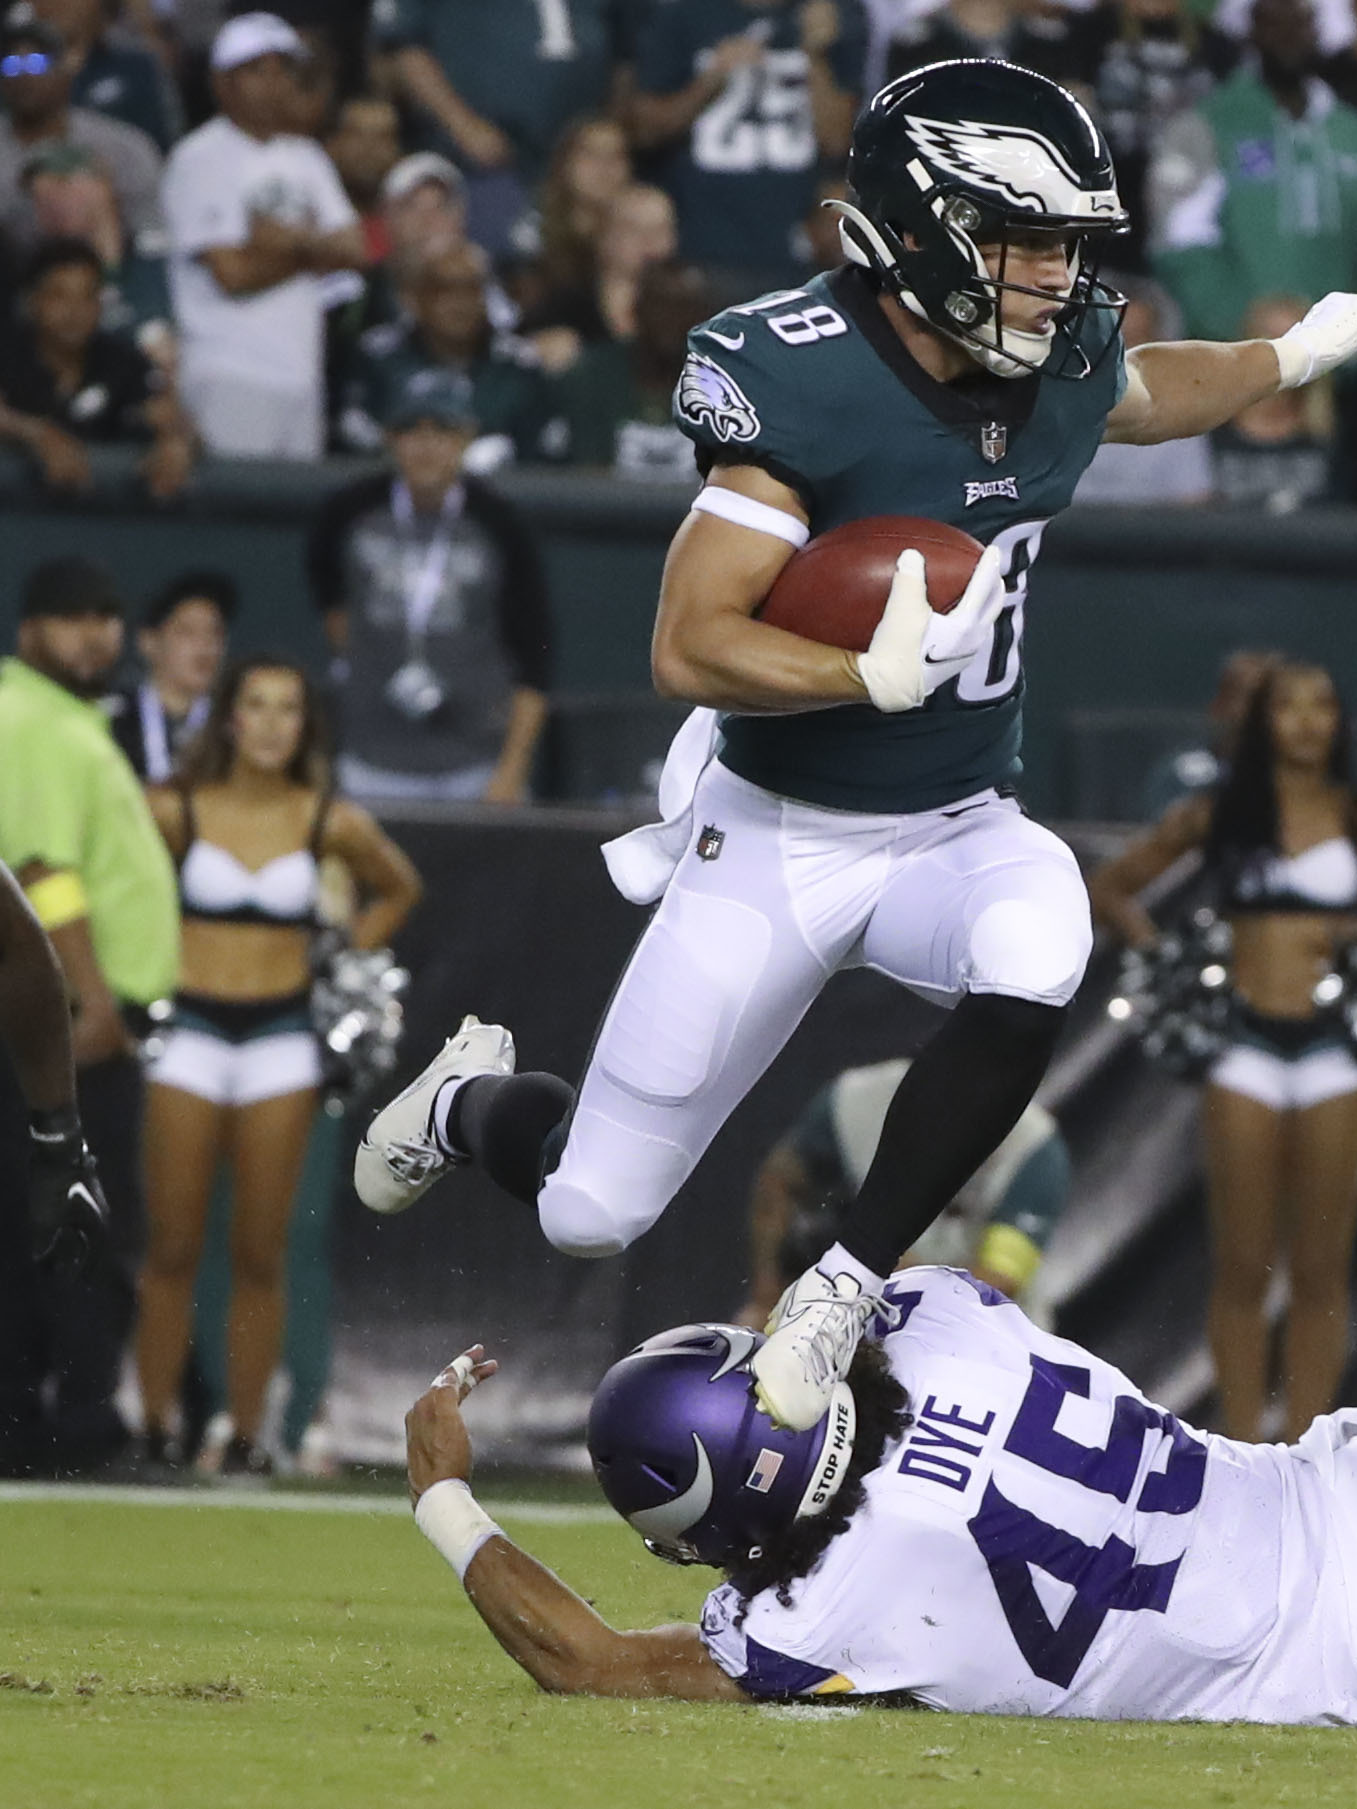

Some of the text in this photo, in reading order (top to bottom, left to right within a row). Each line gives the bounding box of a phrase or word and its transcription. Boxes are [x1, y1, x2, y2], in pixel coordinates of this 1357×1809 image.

[692, 47, 817, 172] 25
[728, 290, 848, 346] 18
[963, 476, 1020, 507] EAGLES
[812, 1403, 849, 1505] STOP HATE
[897, 1394, 996, 1494] DYE
[967, 1352, 1207, 1690] 45
